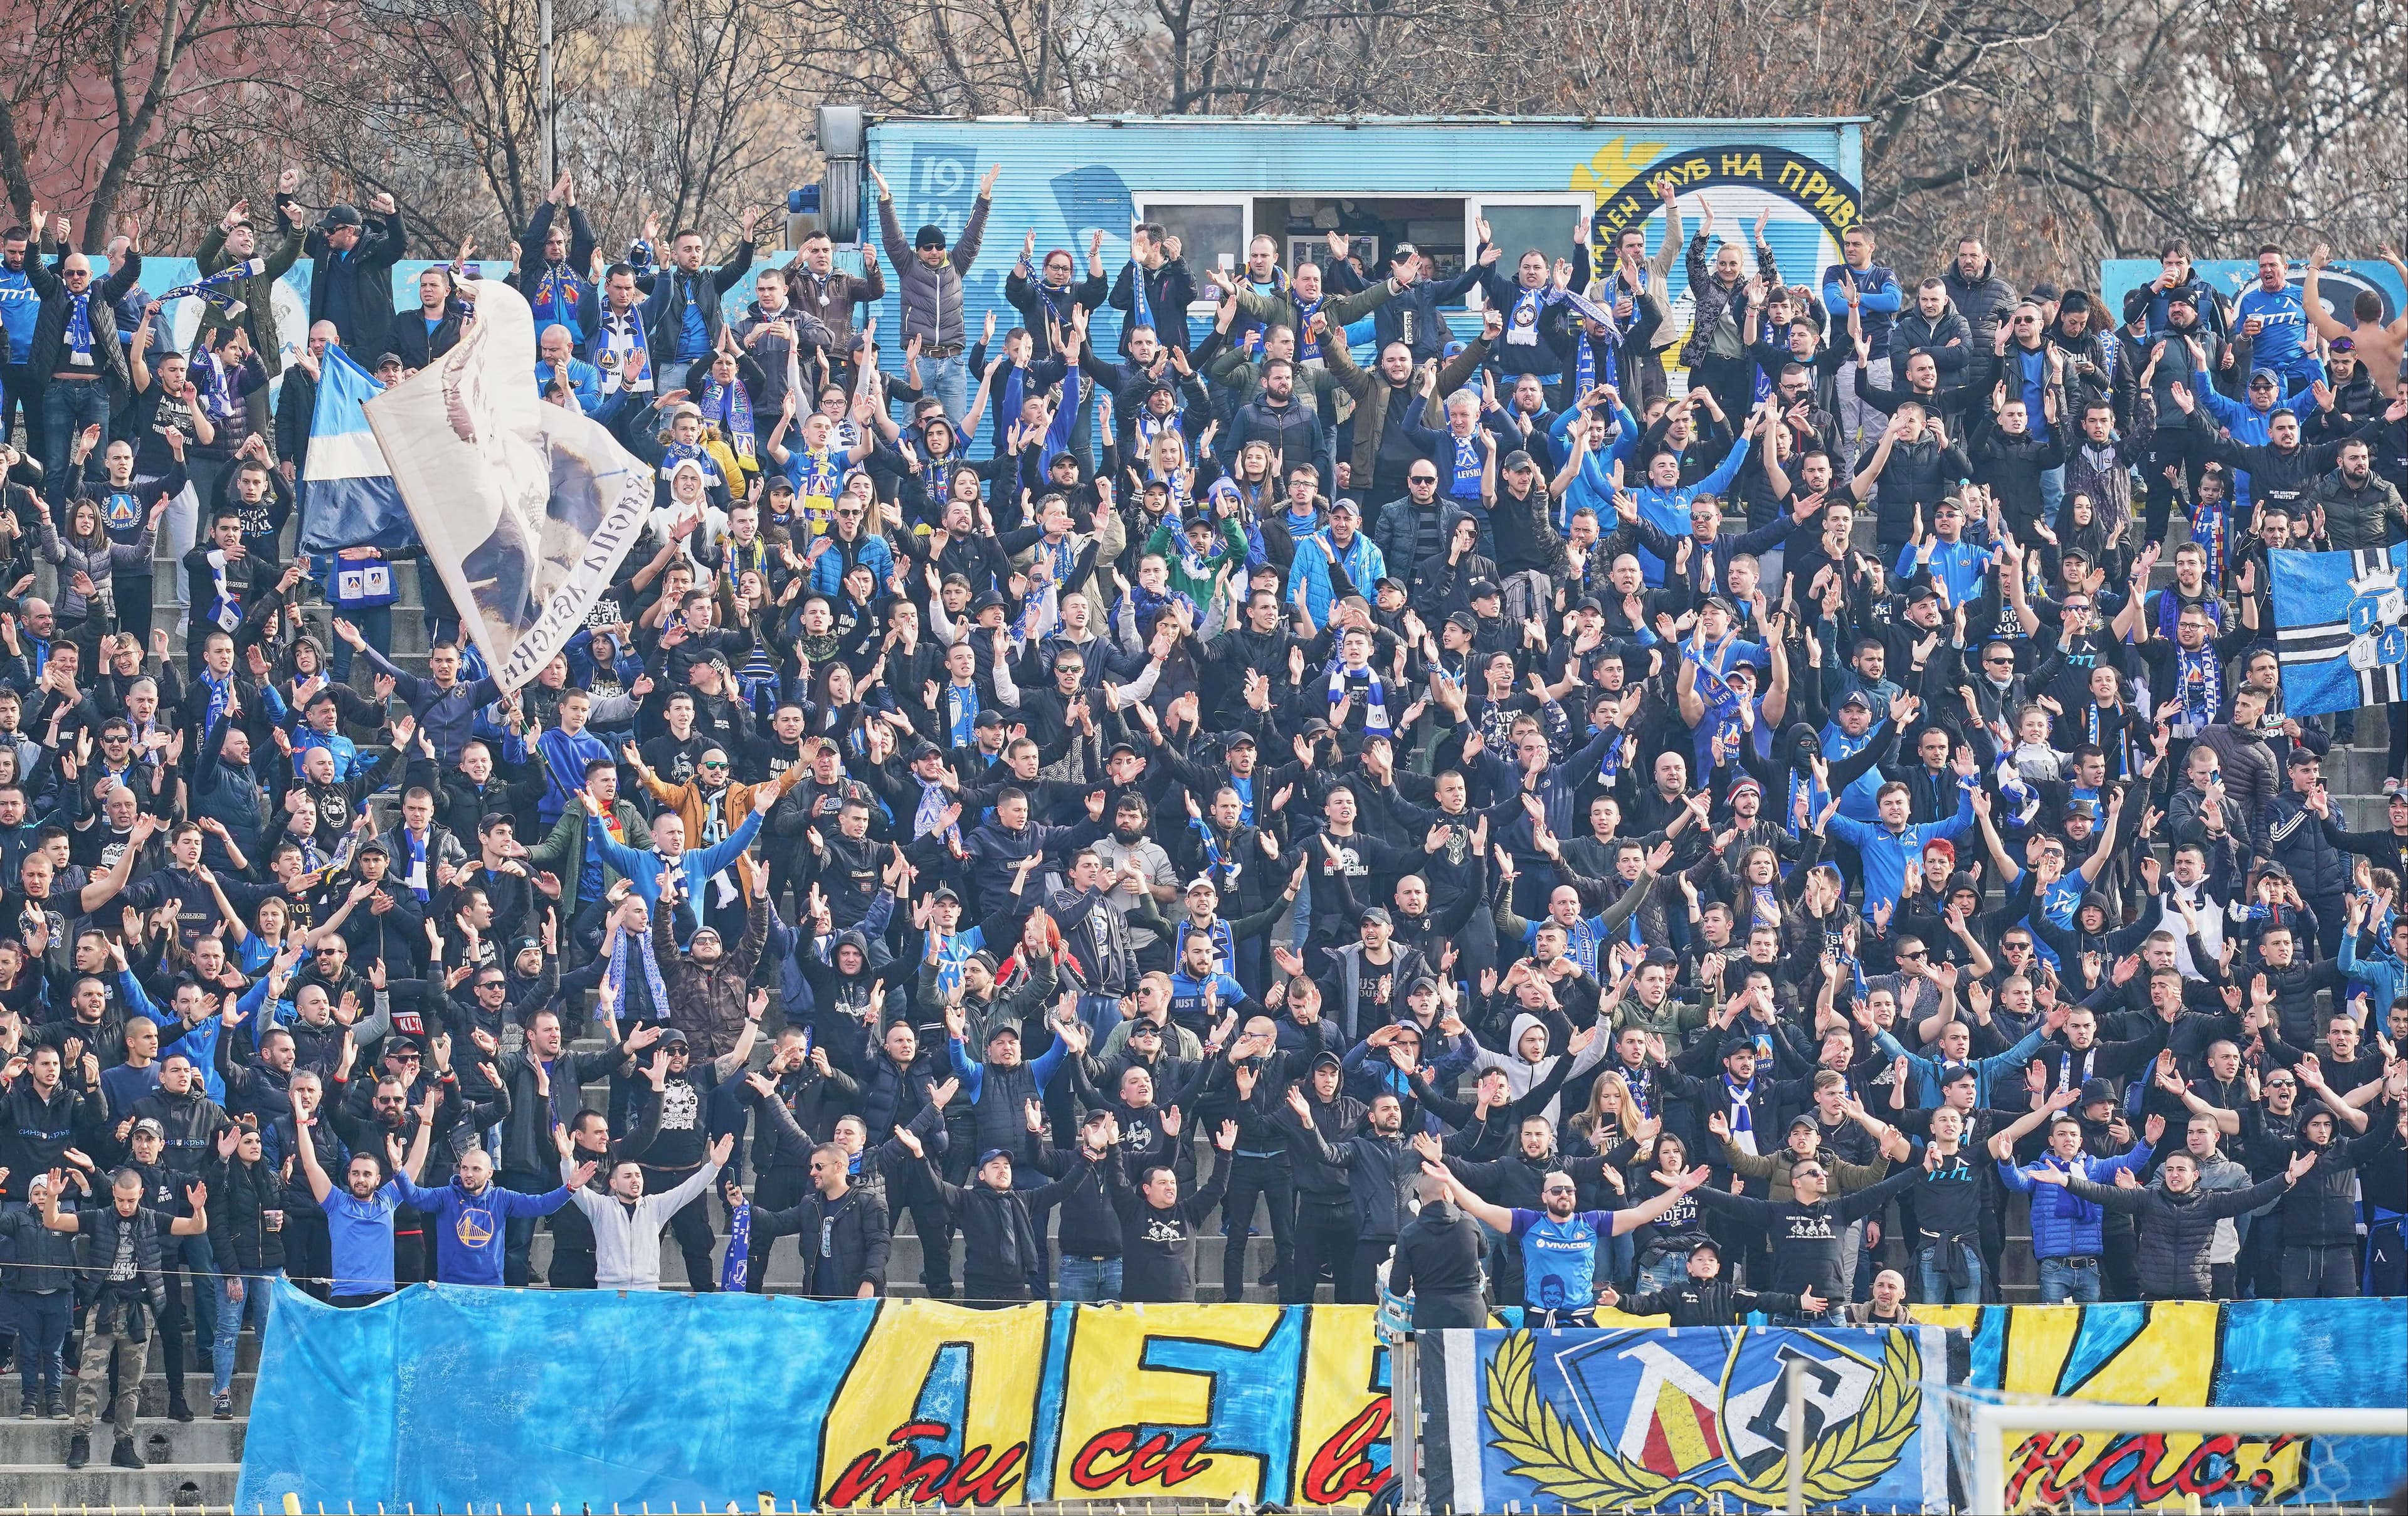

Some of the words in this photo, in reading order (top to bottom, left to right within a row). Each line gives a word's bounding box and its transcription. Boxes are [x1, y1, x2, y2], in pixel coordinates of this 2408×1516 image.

[1721, 152, 1763, 180] НА
[918, 156, 964, 196] 19
[1457, 468, 1481, 479] LEVSKI
[591, 599, 620, 615] EVSKI
[710, 658, 724, 673] 1914
[59, 731, 74, 740] NIKE
[1175, 998, 1195, 1009] JUST
[1757, 1061, 1772, 1070] 1914
[1546, 1241, 1591, 1250] VIVACOM
[1070, 1428, 1213, 1490] си
